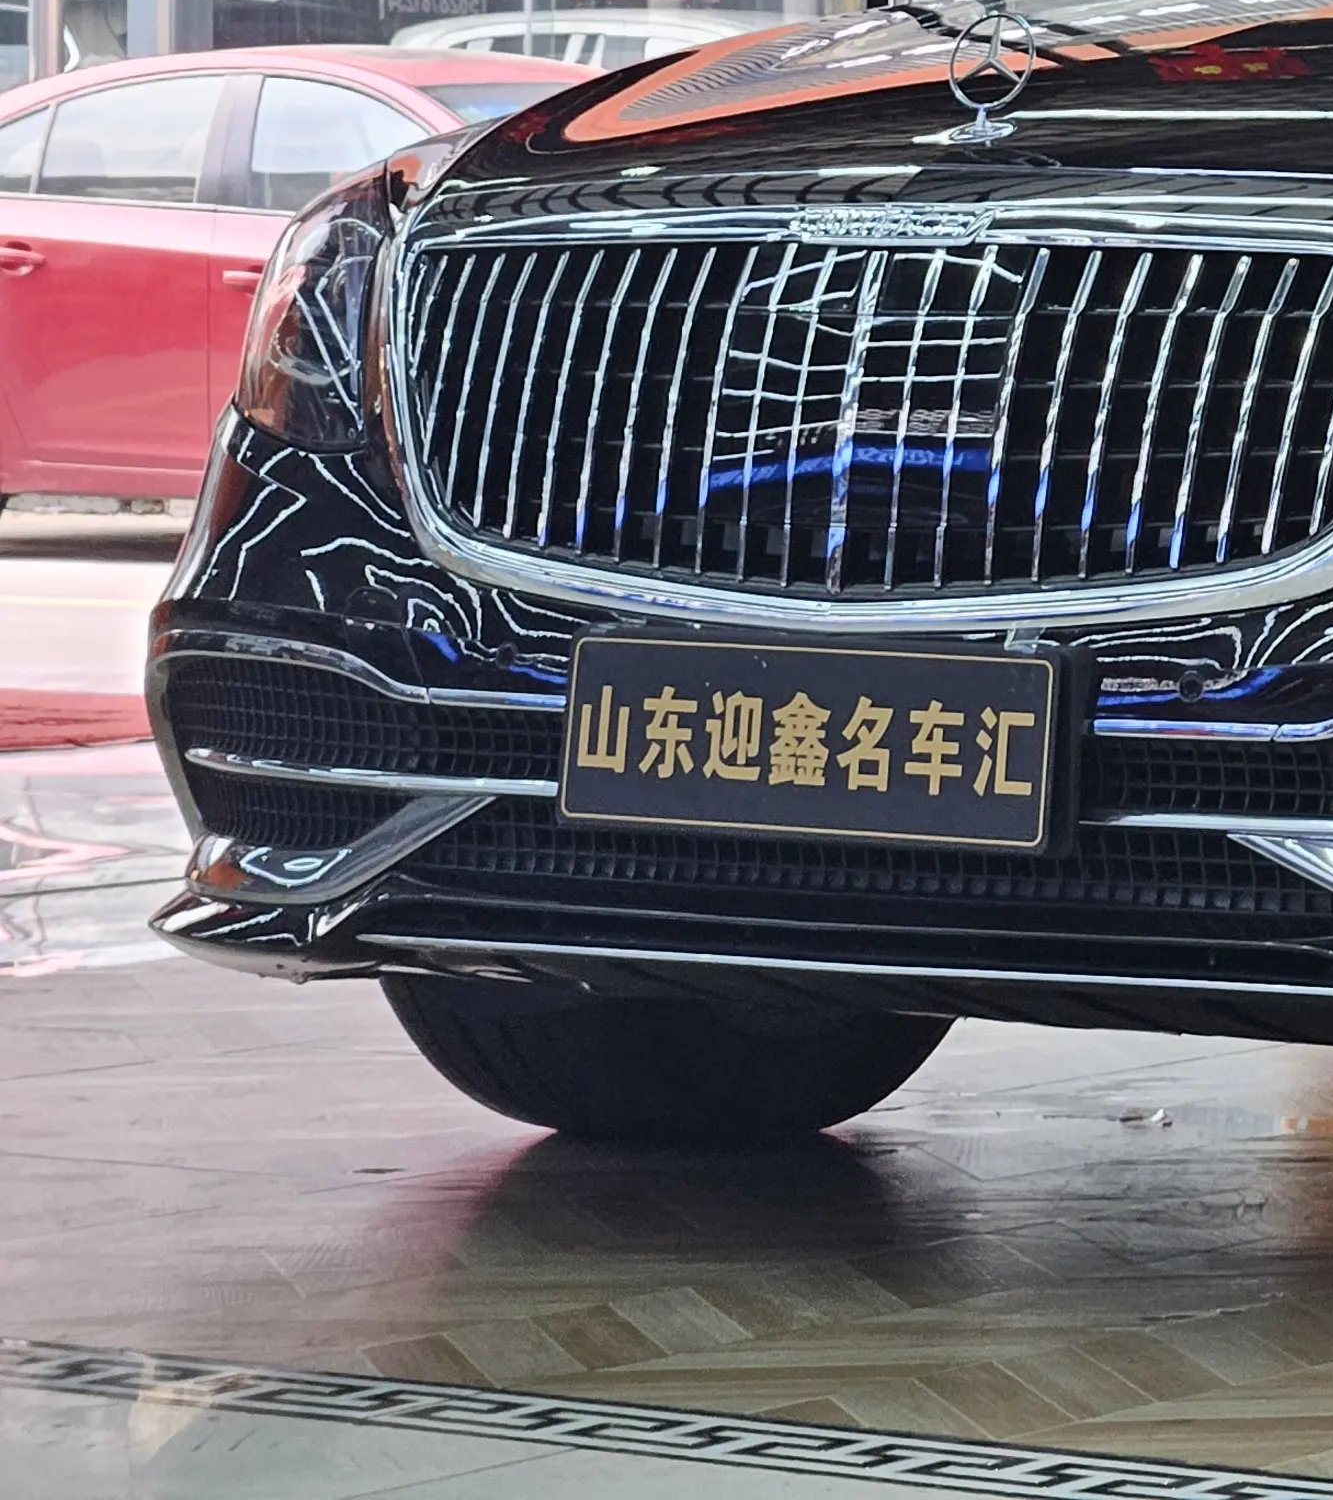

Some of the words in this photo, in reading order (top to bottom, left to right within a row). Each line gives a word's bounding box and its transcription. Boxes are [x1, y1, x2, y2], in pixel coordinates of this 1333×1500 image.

[576, 684, 1036, 797] 山东迎鑫名车汇
